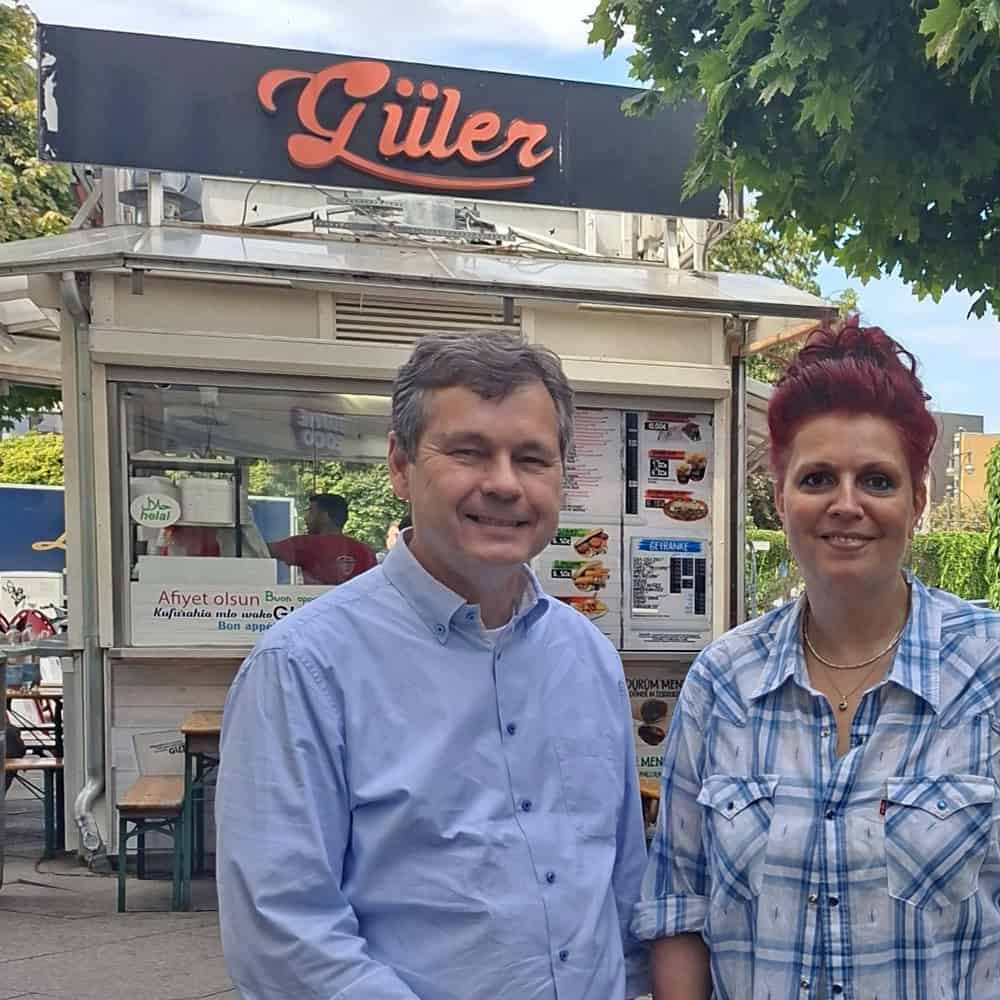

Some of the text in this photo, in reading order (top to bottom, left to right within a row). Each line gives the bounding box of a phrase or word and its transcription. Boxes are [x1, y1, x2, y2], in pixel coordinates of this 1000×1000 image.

[257, 60, 554, 189] Güler
[158, 590, 260, 608] Afiyet olsun
[217, 621, 240, 630] Bon
[661, 679, 684, 689] MEN
[641, 756, 663, 767] MEN
